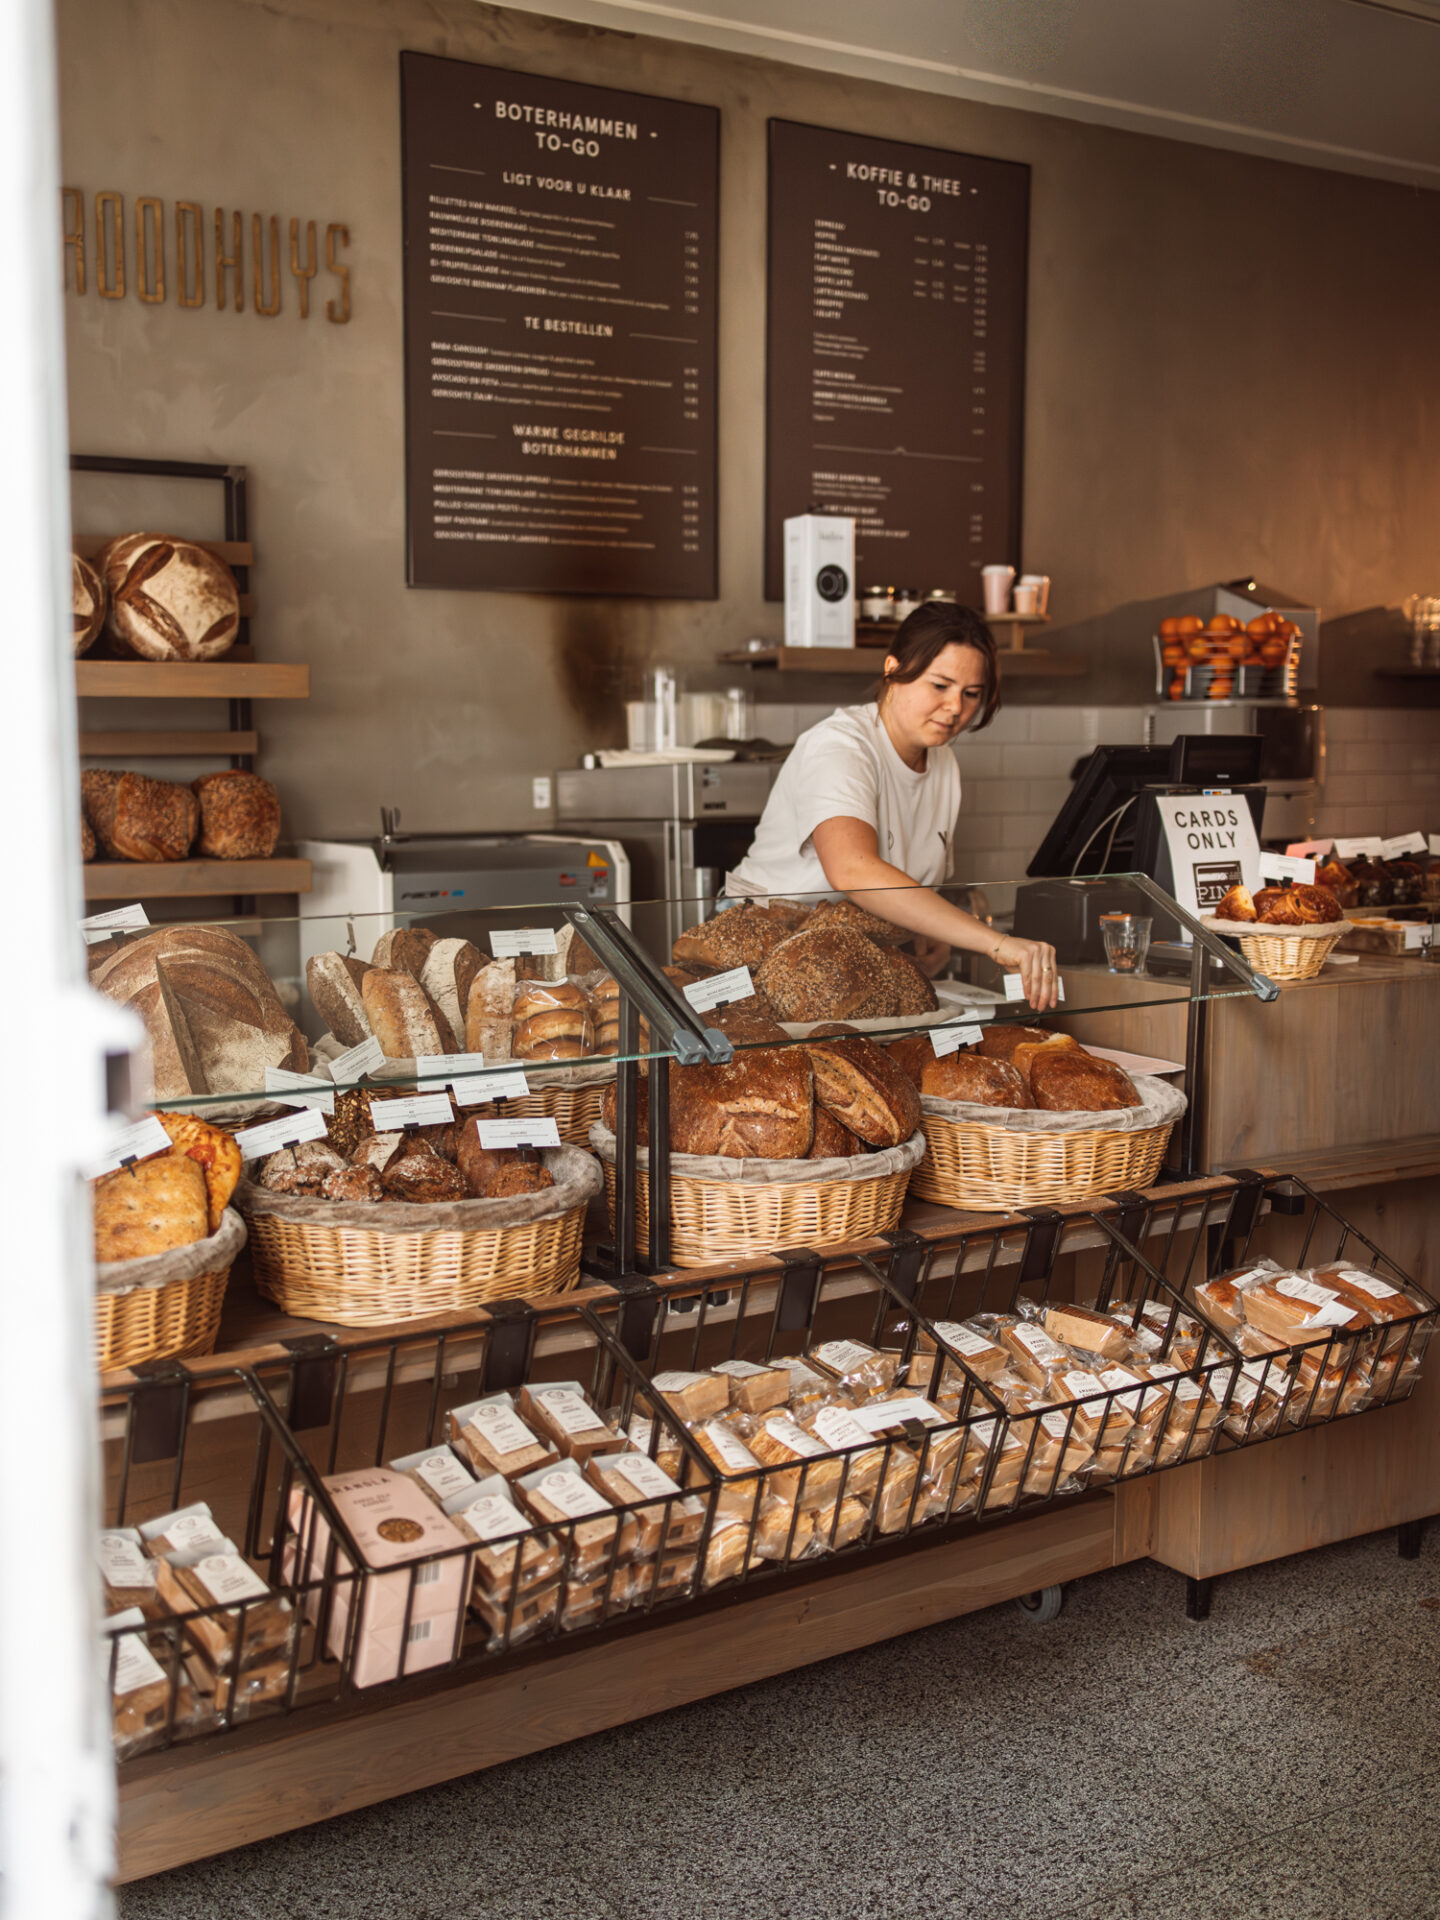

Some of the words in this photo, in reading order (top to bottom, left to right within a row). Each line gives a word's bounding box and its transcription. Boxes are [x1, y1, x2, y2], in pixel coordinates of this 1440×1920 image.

[495, 101, 638, 140] BOTERHAMMEN
[535, 131, 601, 158] TO-GO
[503, 171, 532, 187] LIGT
[537, 177, 573, 193] VOOR
[577, 182, 587, 195] U
[590, 185, 632, 201] KLAAR
[847, 162, 903, 187] KOFFIE
[907, 173, 919, 189] &
[922, 175, 962, 197] THEE
[876, 189, 932, 213] TO-GO
[524, 316, 541, 330] TE
[544, 319, 613, 337] BESTELLEN
[512, 424, 559, 440] WARME
[562, 428, 626, 445] GEGRILDE
[521, 442, 618, 460] BOTERHAMMEN
[1174, 808, 1238, 828] CARDS
[1186, 830, 1236, 850] ONLY
[329, 1476, 393, 1496] RANOLA
